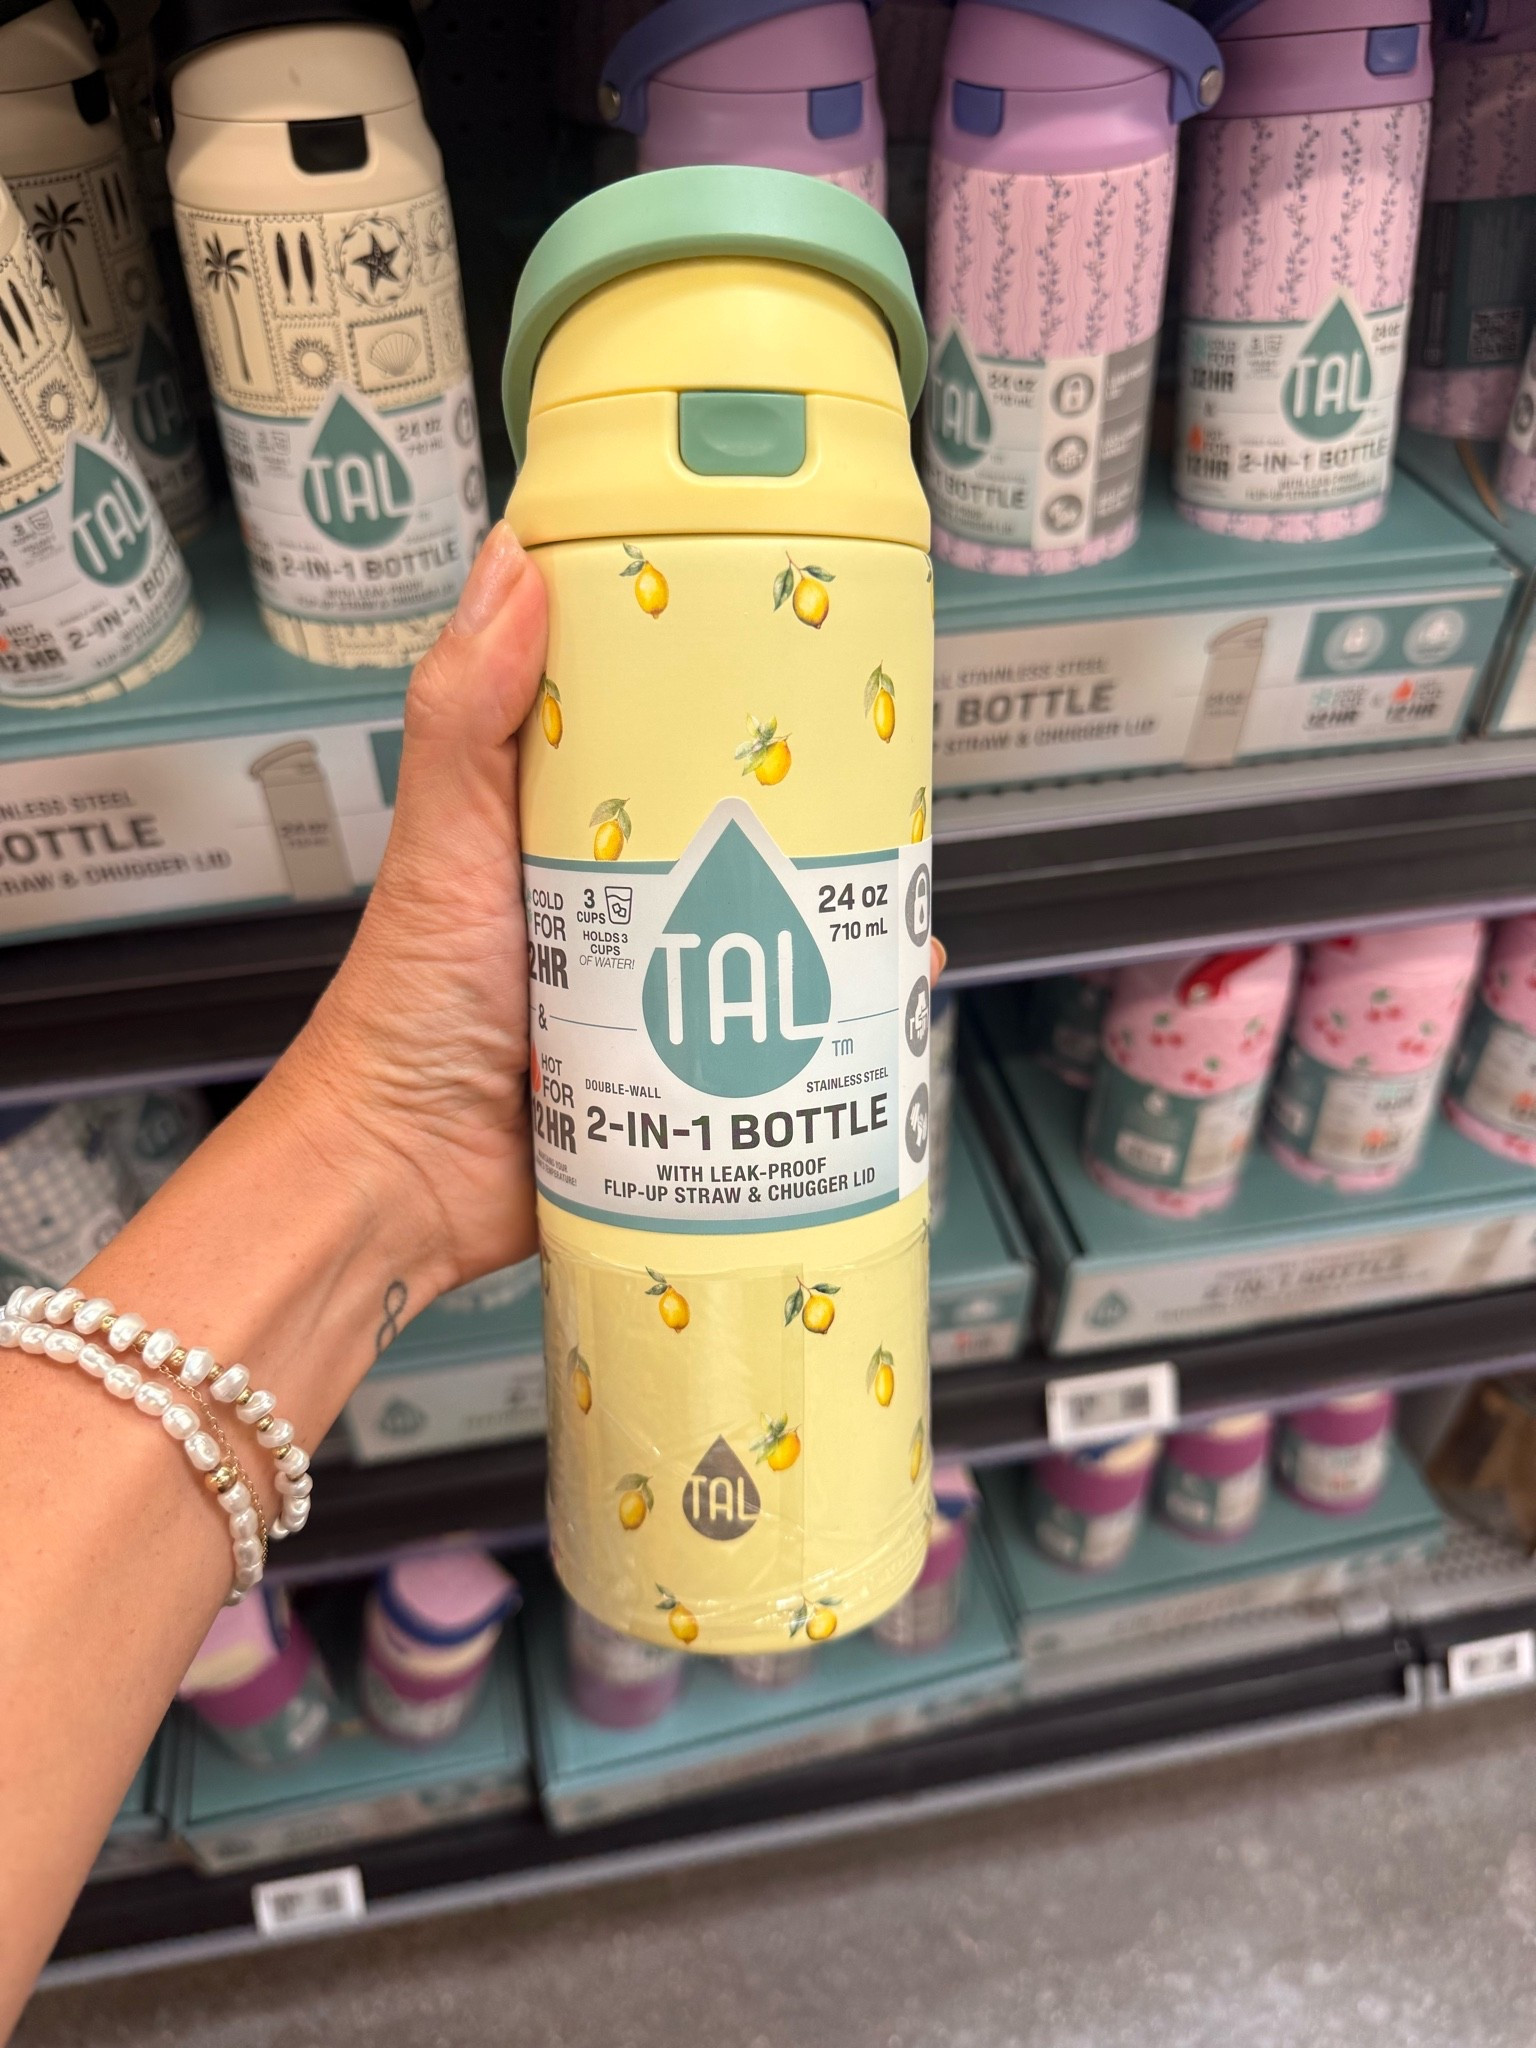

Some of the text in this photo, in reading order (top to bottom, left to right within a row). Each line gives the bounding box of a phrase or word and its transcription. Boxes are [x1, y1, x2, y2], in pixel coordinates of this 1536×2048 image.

[1290, 350, 1379, 418] TAL
[1237, 437, 1388, 474] 2-IN-1 BOTTLE
[307, 452, 414, 525] TAL
[945, 474, 1026, 510] BOTTLE
[73, 476, 150, 575] TAL
[281, 540, 461, 582] 2-IN-1 BOTTLE
[67, 592, 143, 652] 2-IN-1
[956, 679, 1118, 728] BOTTLE
[70, 788, 133, 813] STEEL
[0, 814, 165, 868] OTTLE
[533, 888, 564, 911] COLD
[583, 888, 596, 909] 3
[818, 882, 888, 914] 24 oz
[534, 911, 567, 941] FOR
[576, 910, 606, 925] CUPS
[829, 918, 888, 942] 710 mL
[583, 930, 628, 944] HOLDS 3
[590, 944, 621, 956] CUPS
[527, 941, 569, 990] 2HR
[579, 954, 635, 970] OF WATER!
[650, 929, 829, 1046] TAL
[538, 1003, 549, 1031] &
[541, 1053, 563, 1076] HOT
[806, 1066, 889, 1093] STAINLESS STEEL
[543, 1075, 575, 1109] FOR
[585, 1078, 662, 1099] DOUBLE-WALL
[587, 1092, 888, 1151] 2-IN-1 BOTTLE
[604, 1166, 876, 1204] FLIP-UP STRAW & CHUGGER LID
[656, 1157, 827, 1183] WITH LEAK-PROOF
[689, 1474, 763, 1521] TAL
